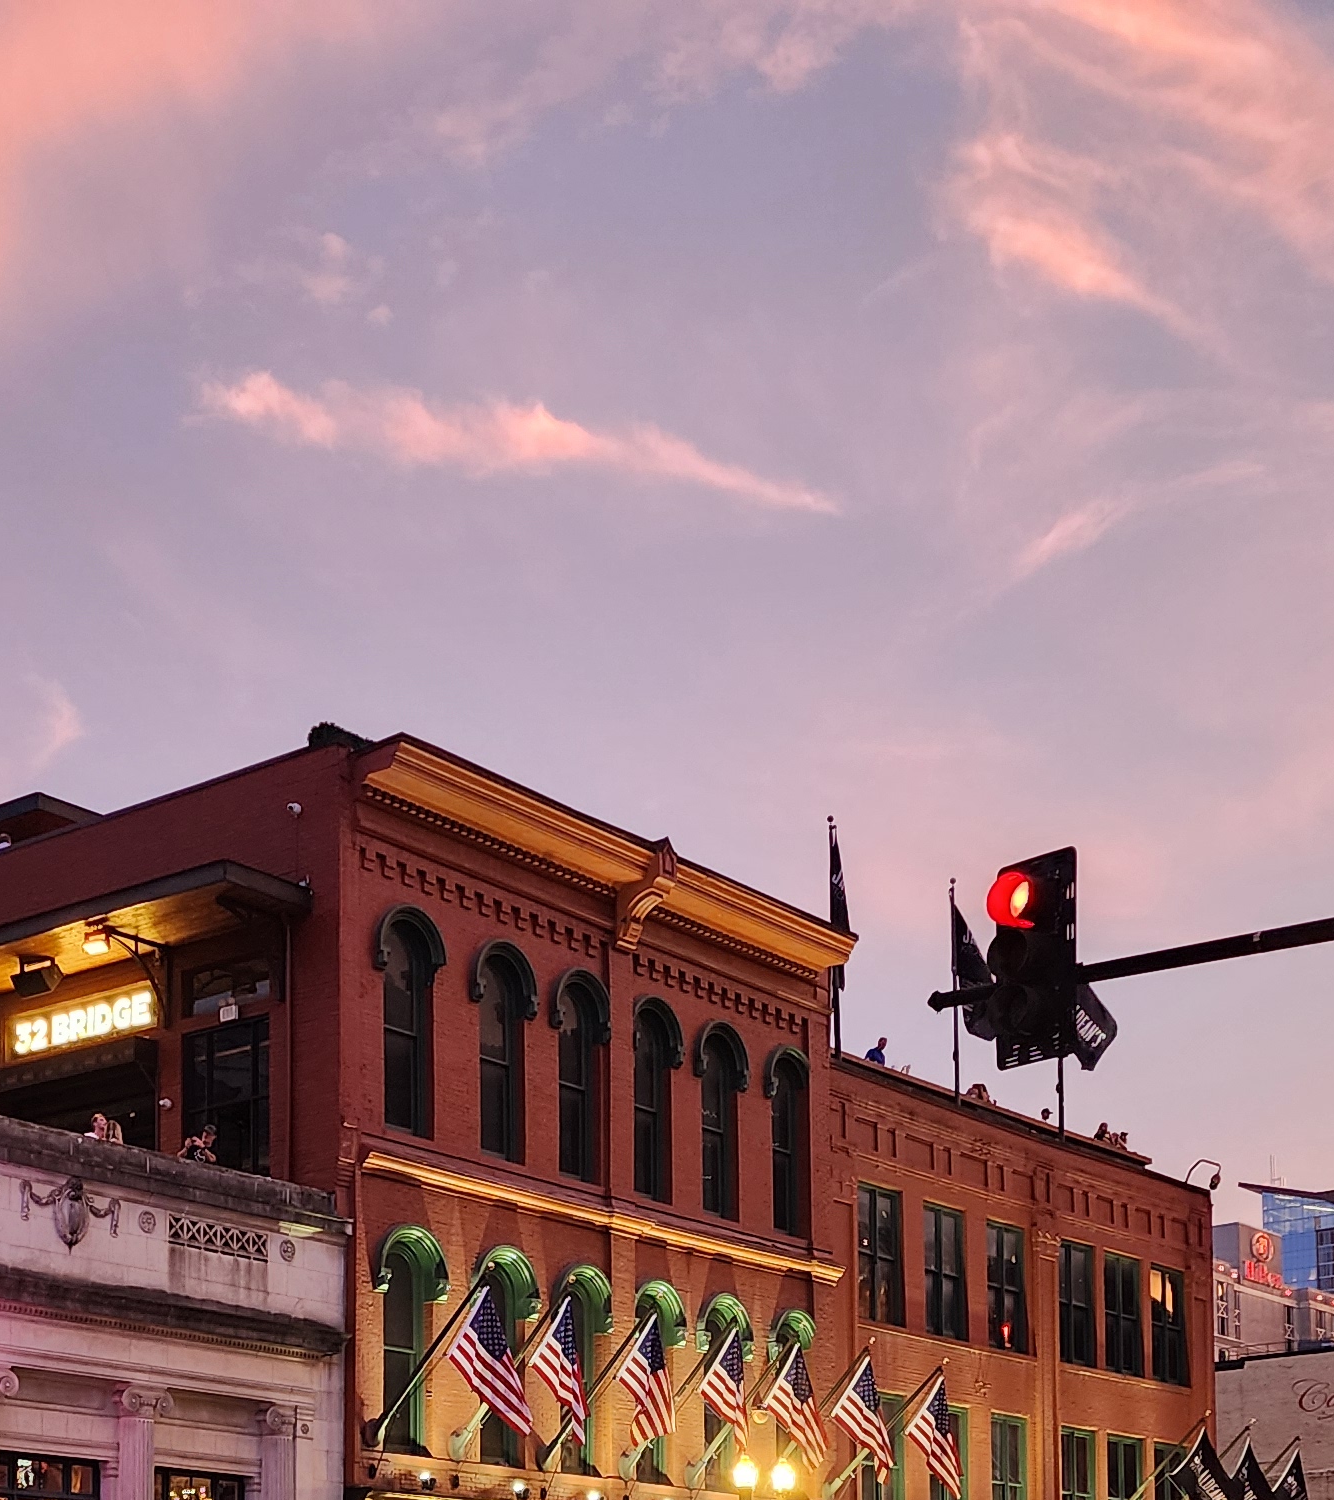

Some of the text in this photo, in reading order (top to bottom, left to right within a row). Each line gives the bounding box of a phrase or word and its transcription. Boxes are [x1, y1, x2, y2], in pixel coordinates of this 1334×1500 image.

[14, 990, 153, 1055] 32 BRIDGE
[1076, 1005, 1107, 1048] DEAN'S
